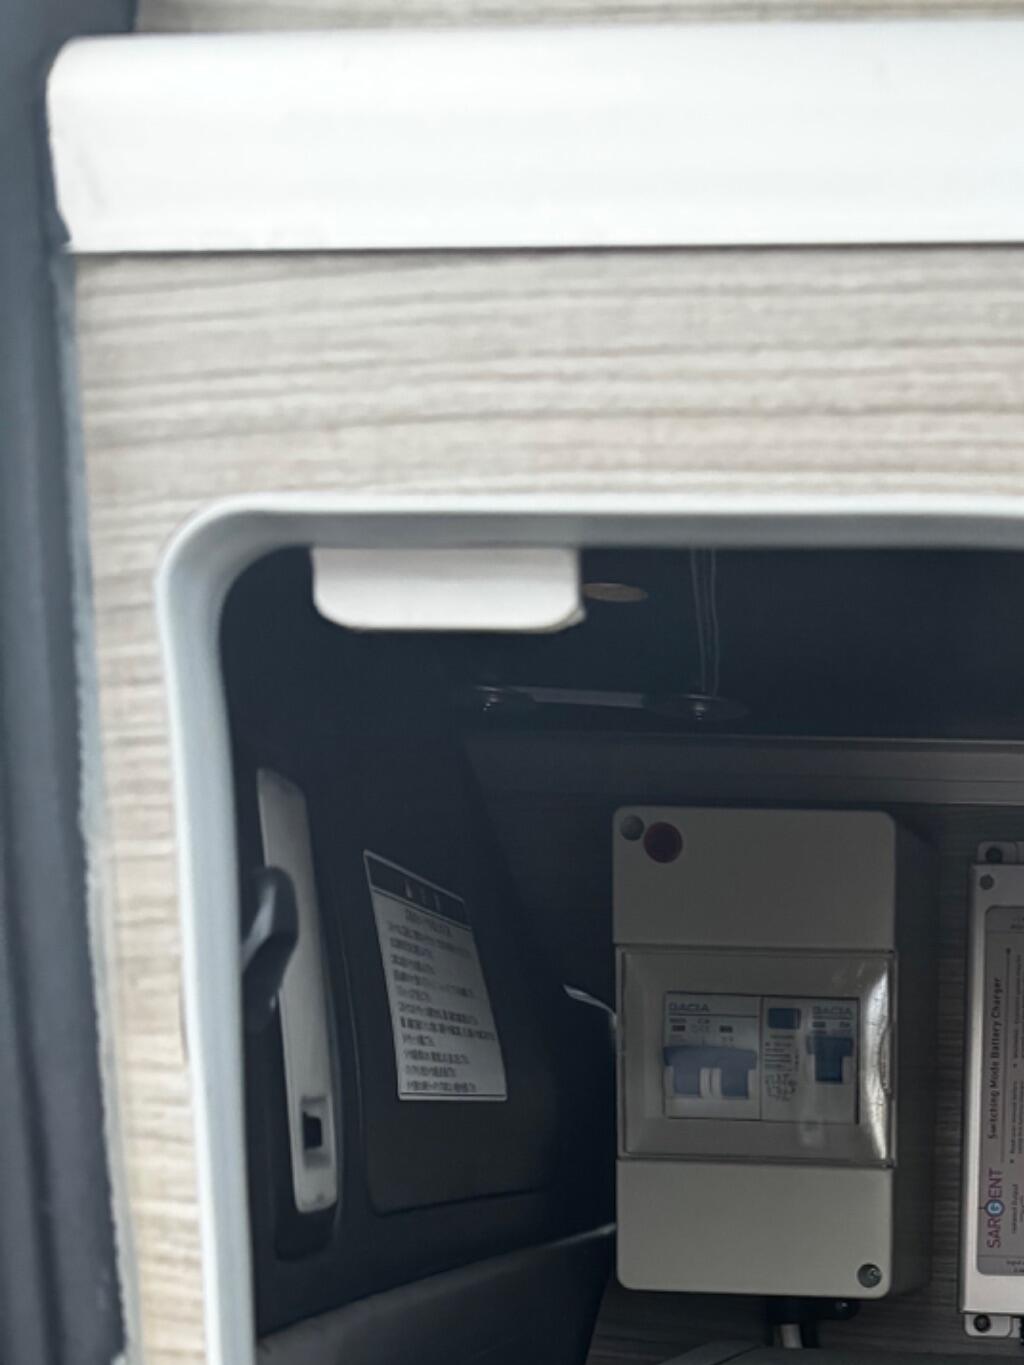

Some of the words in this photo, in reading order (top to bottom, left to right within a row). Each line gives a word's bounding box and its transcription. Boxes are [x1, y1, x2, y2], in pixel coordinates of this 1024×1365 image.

[991, 977, 1003, 1019] Charger
[990, 1021, 1002, 1059] Battery
[989, 1061, 1000, 1089] Mode
[985, 1168, 1005, 1248] SARGENT
